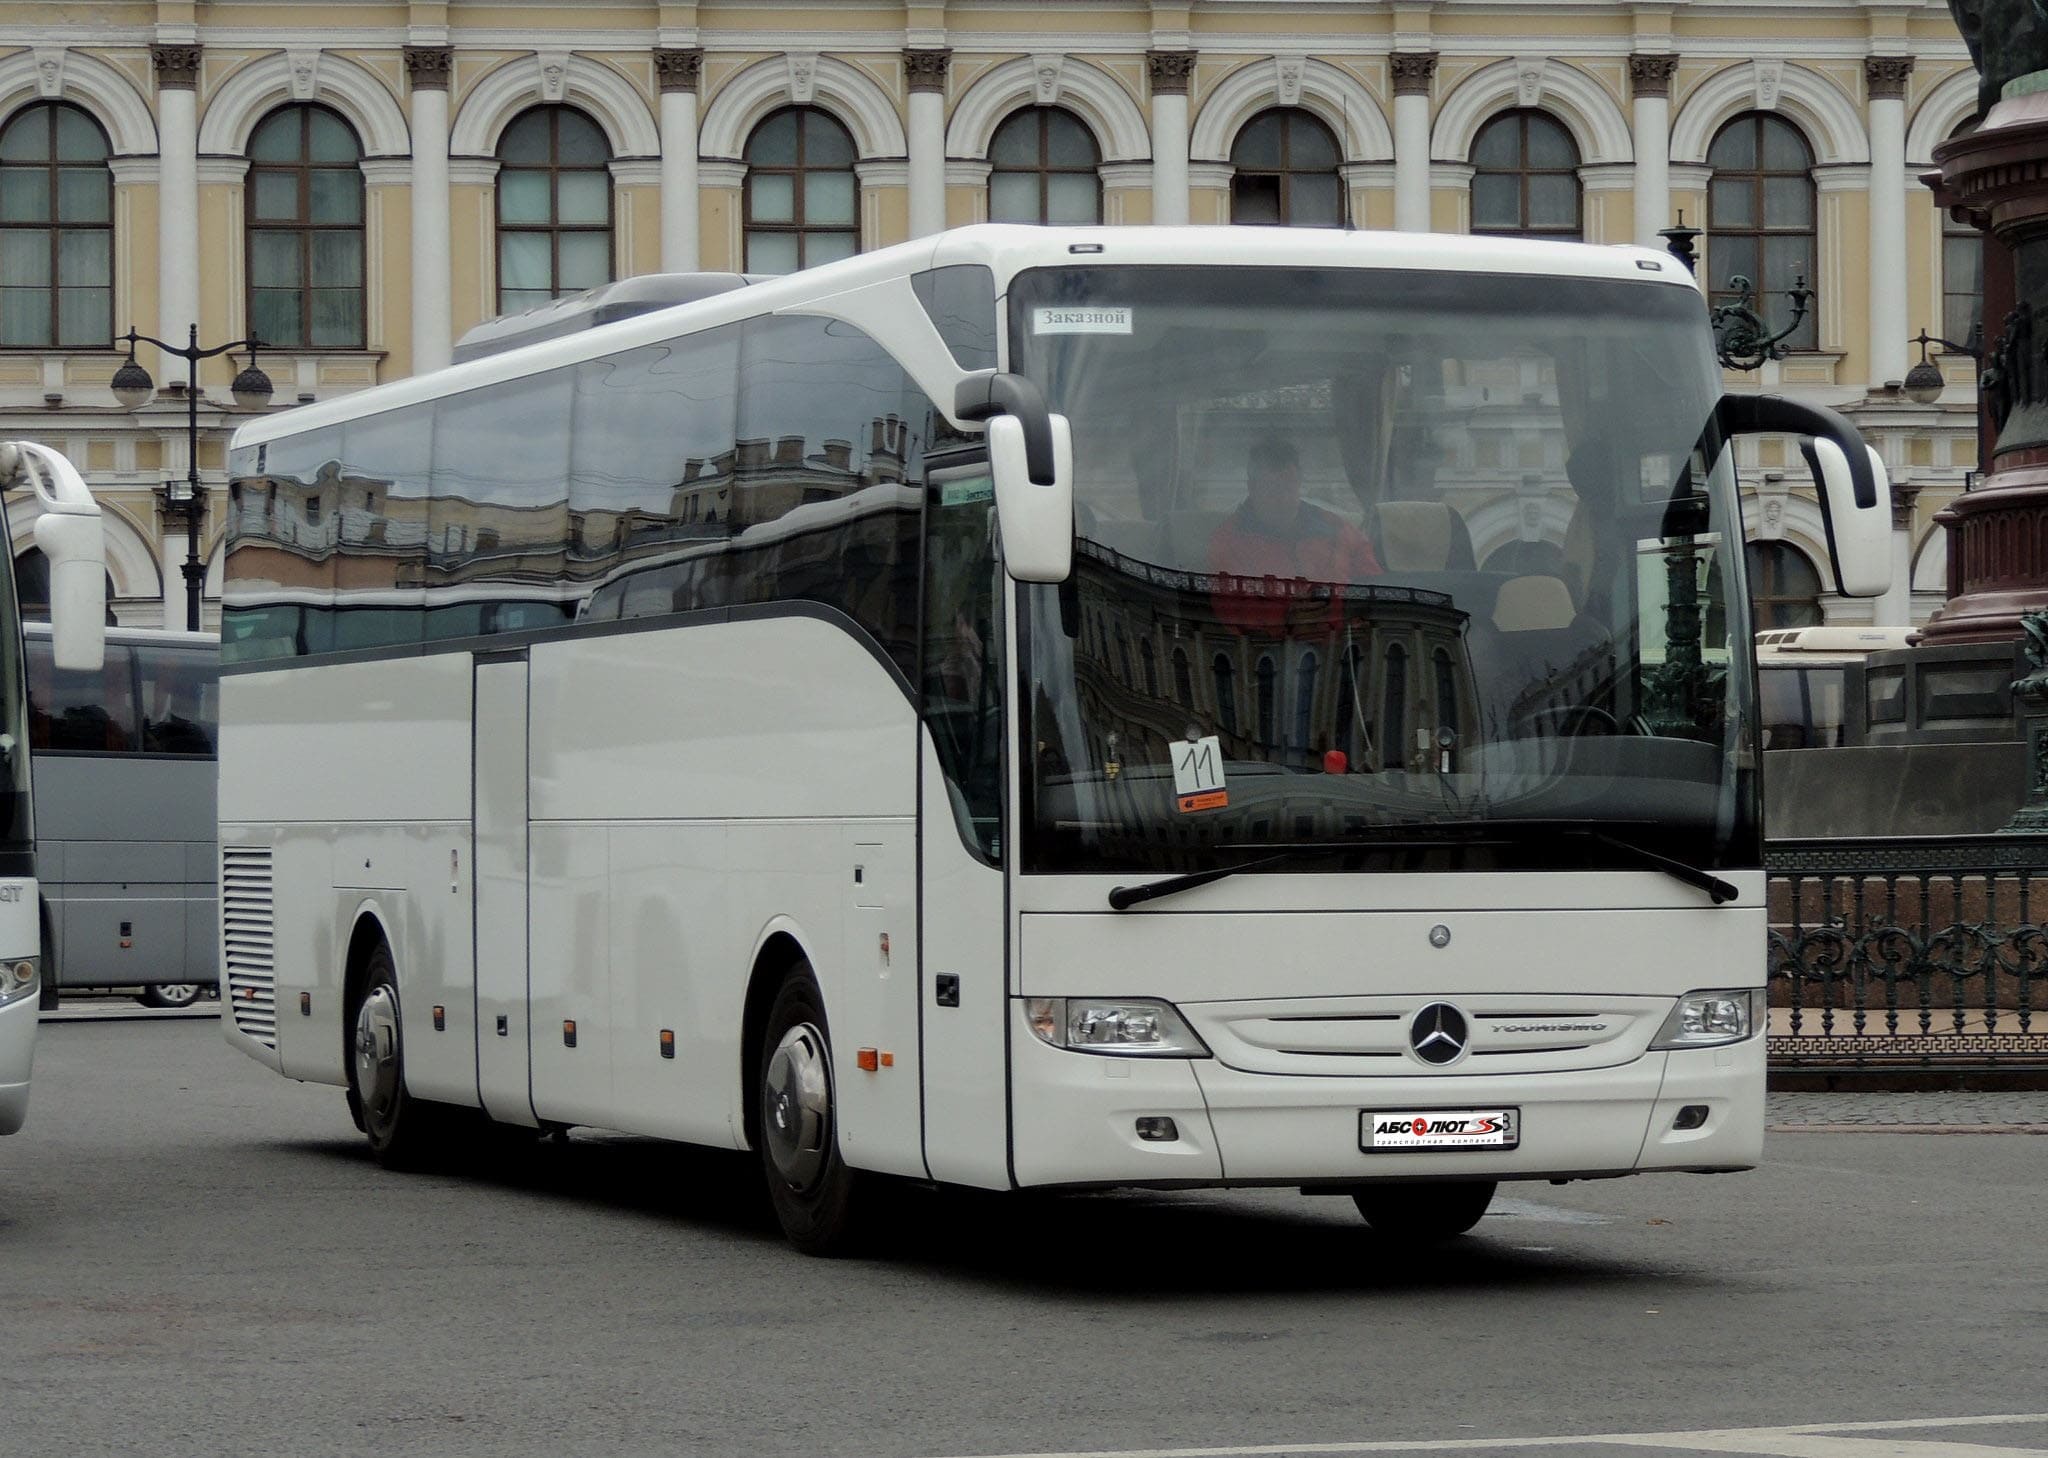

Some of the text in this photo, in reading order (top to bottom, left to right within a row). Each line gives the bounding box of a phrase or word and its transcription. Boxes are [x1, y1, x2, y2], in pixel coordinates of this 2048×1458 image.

[1043, 310, 1125, 325] Заказной
[1180, 744, 1216, 788] 11
[1491, 1023, 1608, 1033] TOURISMO
